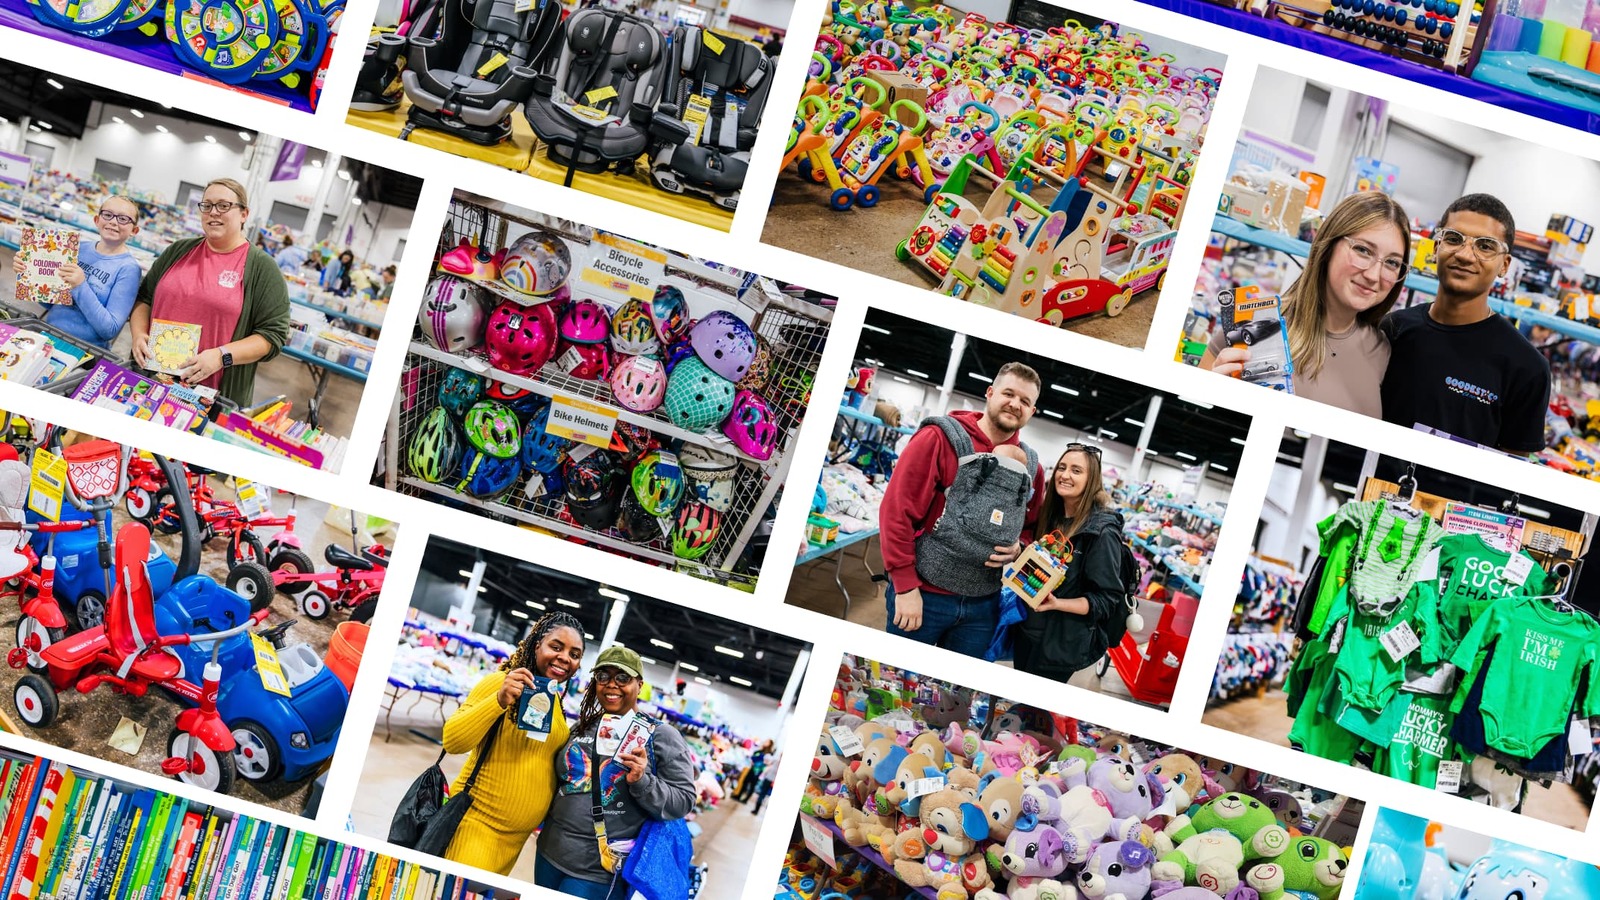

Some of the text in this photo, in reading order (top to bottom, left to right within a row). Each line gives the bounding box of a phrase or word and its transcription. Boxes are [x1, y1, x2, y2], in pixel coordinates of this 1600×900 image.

[34, 258, 62, 268] COLORING
[608, 249, 644, 269] Bicycle
[38, 268, 55, 276] BOOK
[92, 268, 111, 285] CLUB
[593, 258, 650, 286] Accessories
[1239, 300, 1274, 311] MATCHBOX
[1445, 376, 1486, 397] GOODEST
[554, 409, 609, 431] Bike Helmets
[1473, 520, 1499, 530] CLOTHING
[1465, 557, 1506, 580] GOO
[1461, 568, 1518, 598] LUCK
[1523, 637, 1549, 657] I'M
[1526, 628, 1565, 648] KISS ME
[1520, 650, 1557, 670] IRISH
[1408, 702, 1444, 721] MOMMY'S
[197, 827, 206, 842] Space!
[102, 864, 110, 876] CAT
[107, 871, 115, 882] CAT
[117, 839, 125, 851] HAT
[281, 878, 290, 891] Go!
